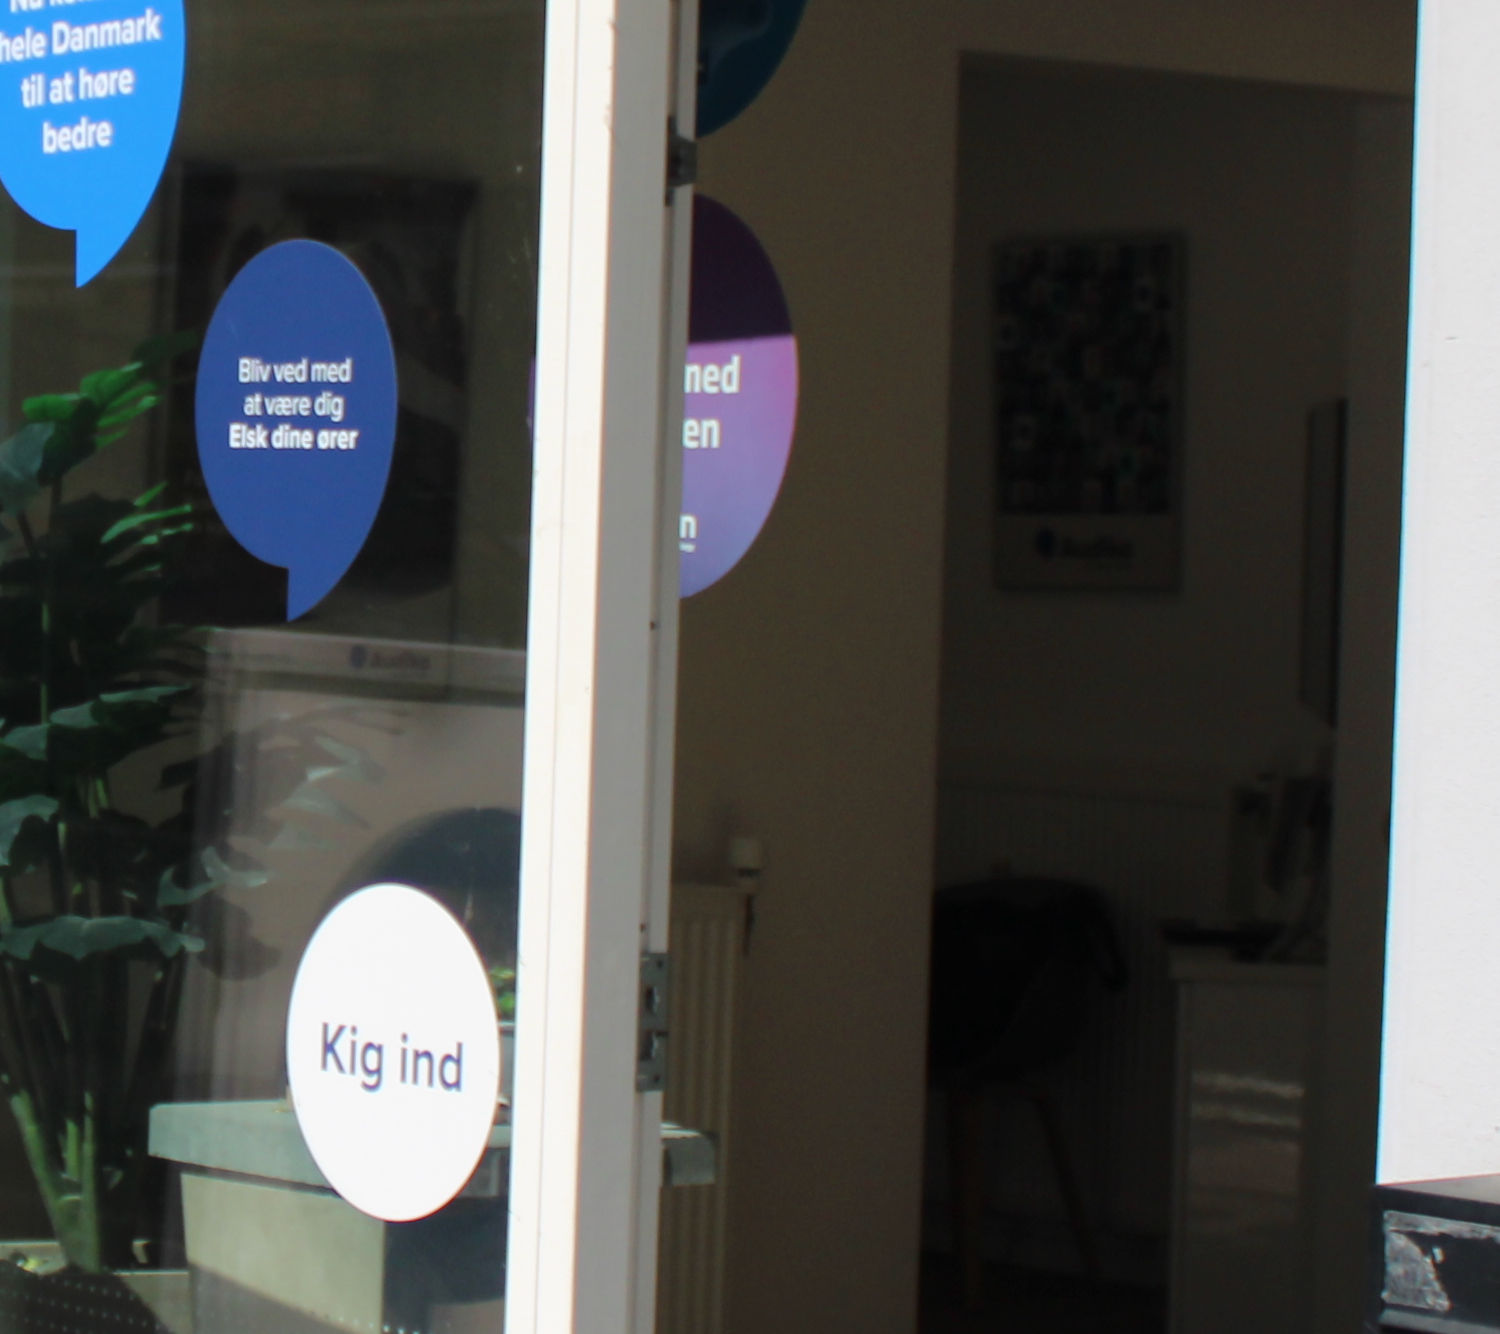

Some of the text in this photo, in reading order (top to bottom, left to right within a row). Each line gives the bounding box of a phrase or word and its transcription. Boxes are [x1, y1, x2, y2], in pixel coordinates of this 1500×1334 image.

[52, 8, 163, 55] Danmark
[21, 68, 135, 109] til at høre
[42, 116, 114, 155] bedre
[238, 356, 354, 384] Bliv ved med
[243, 390, 346, 423] at være dig
[229, 423, 360, 451] Elsk dine ører
[320, 1021, 464, 1093] Kig ind
